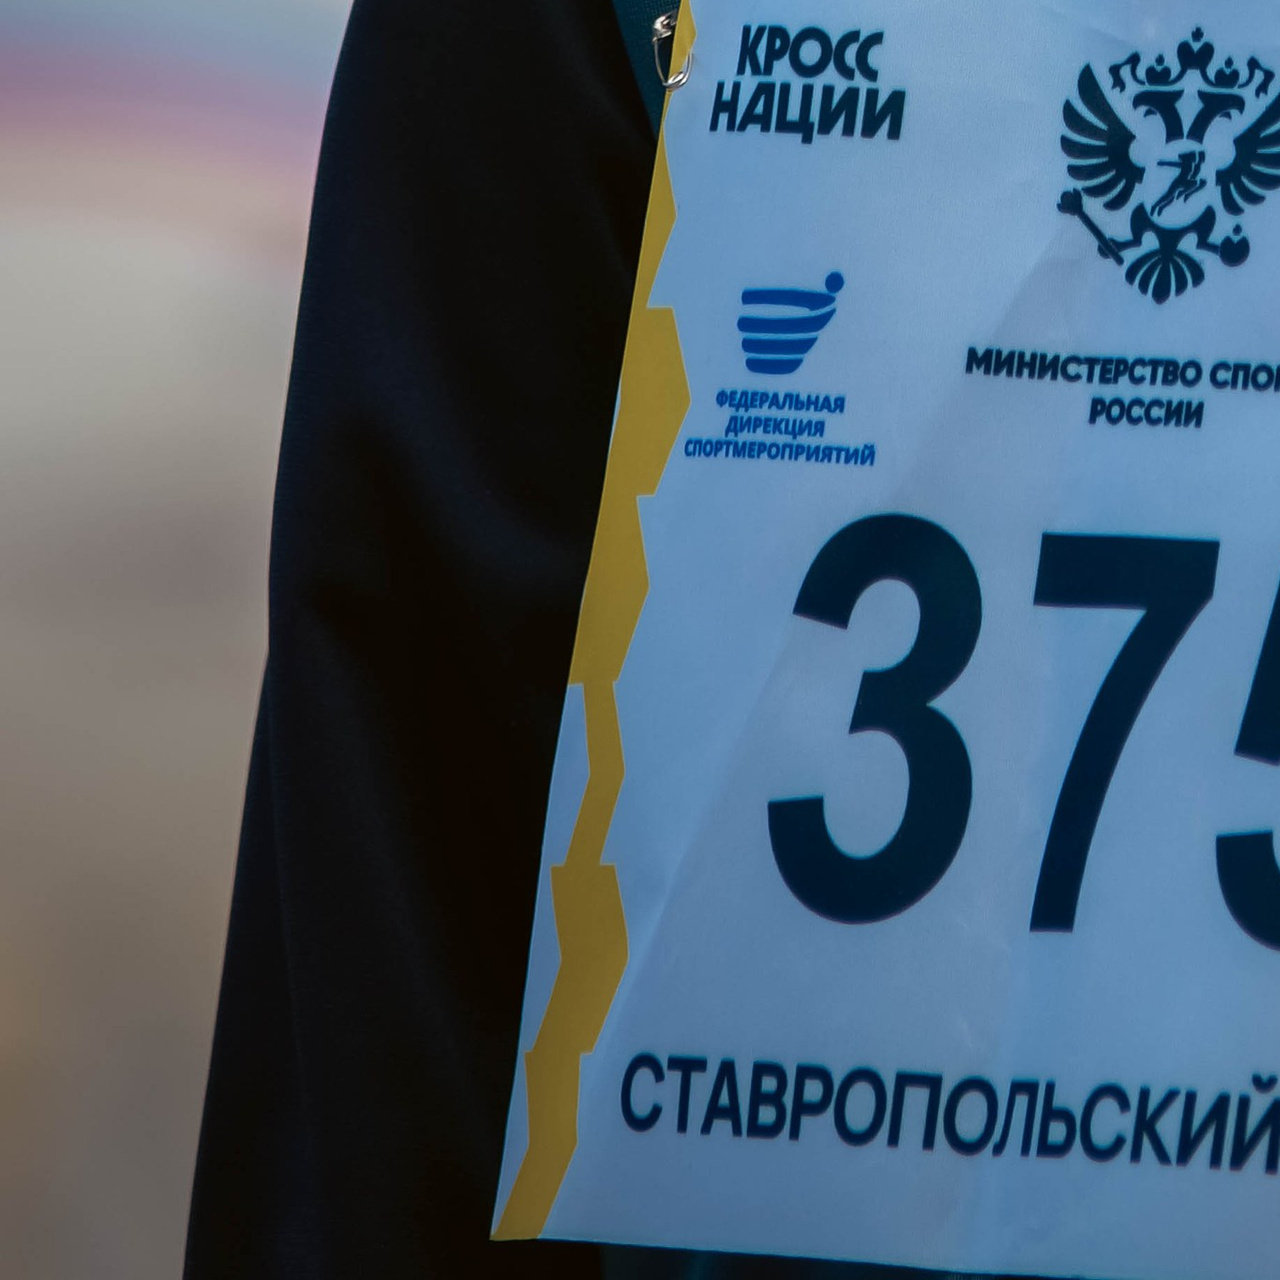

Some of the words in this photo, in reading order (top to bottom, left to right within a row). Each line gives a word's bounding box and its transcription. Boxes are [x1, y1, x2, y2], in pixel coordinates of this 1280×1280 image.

[736, 24, 884, 82] КРОСС
[709, 80, 906, 144] НАЦИИ
[965, 347, 1203, 388] МИНИСТЕРСТВО
[715, 390, 846, 413] ФЕДЕРАЛЬНАЯ
[1088, 397, 1205, 428] РОССИИ
[724, 415, 826, 440] ДИРЕКЦИЯ
[684, 438, 877, 467] СПОРТМЕРОПРИЯТИЙ
